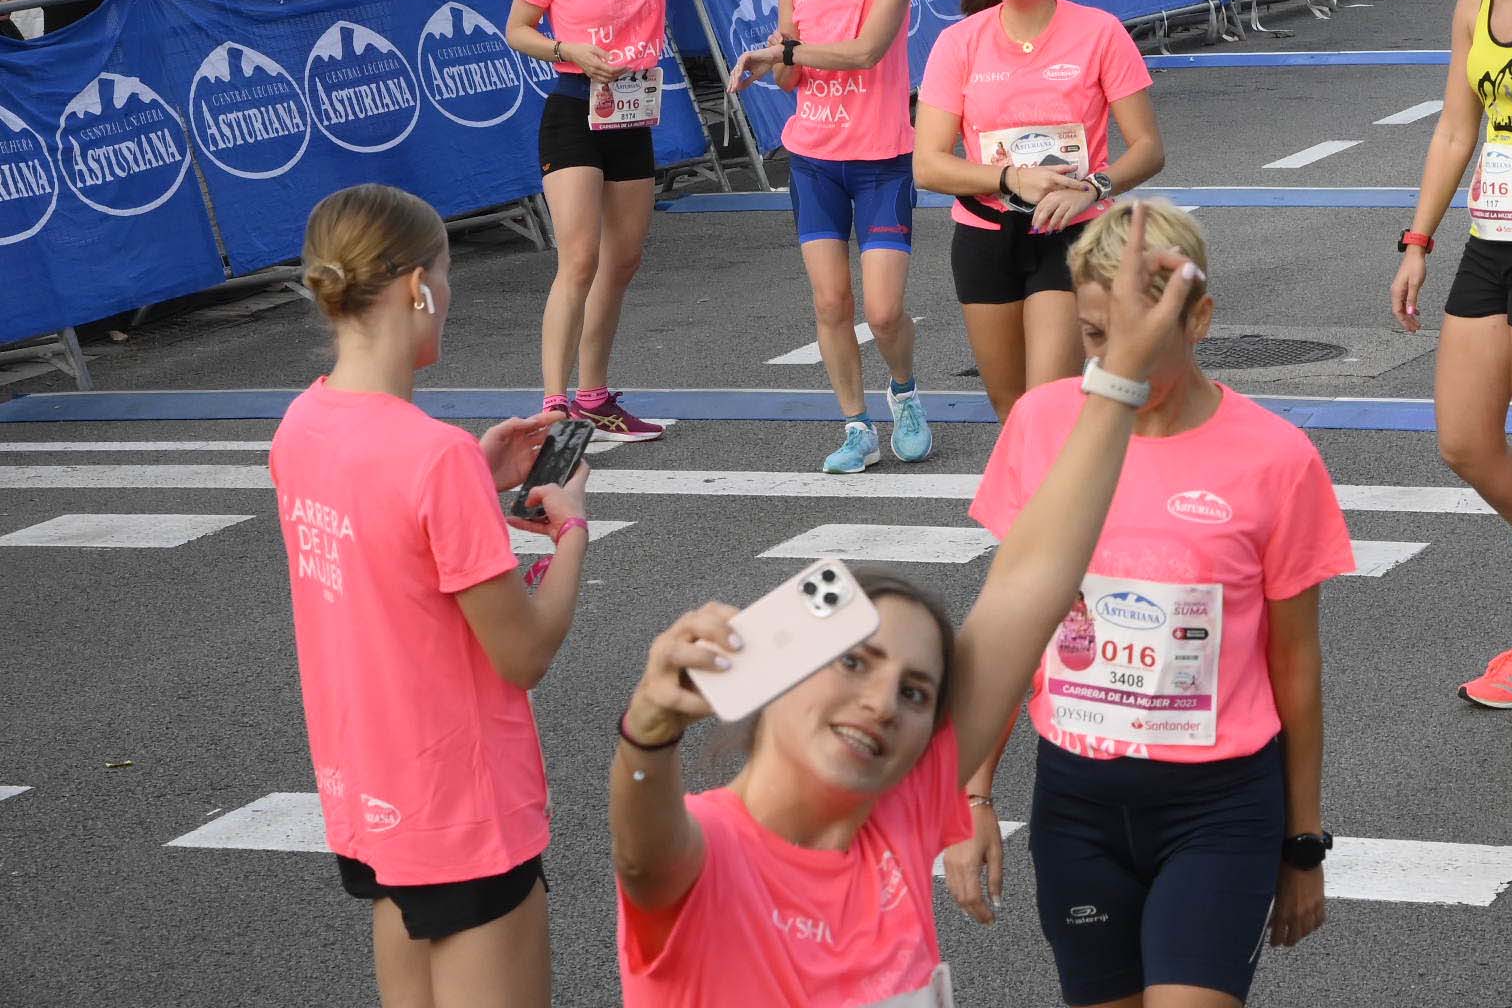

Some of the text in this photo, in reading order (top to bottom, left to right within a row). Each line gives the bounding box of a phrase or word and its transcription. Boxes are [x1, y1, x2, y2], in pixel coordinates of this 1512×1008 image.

[587, 25, 614, 45] TU
[606, 40, 662, 65] ORSAL
[362, 57, 400, 75] LECHERA
[428, 52, 520, 102] ASTURIANA
[315, 75, 416, 126] ASTURIANA
[616, 98, 640, 111] 016
[801, 101, 850, 121] SUMA
[201, 99, 305, 152] ASTURIANA
[298, 525, 339, 561] DE LA
[299, 551, 344, 596] MUJER
[1102, 601, 1160, 625] ASTURIANA
[1173, 607, 1209, 617] SUMA
[1101, 640, 1157, 668] 016
[1110, 671, 1144, 688] 3408
[1062, 684, 1198, 708] CARRERA DE LA MUJER 2023
[1056, 705, 1104, 725] OYSHO
[1144, 719, 1201, 732] Santander
